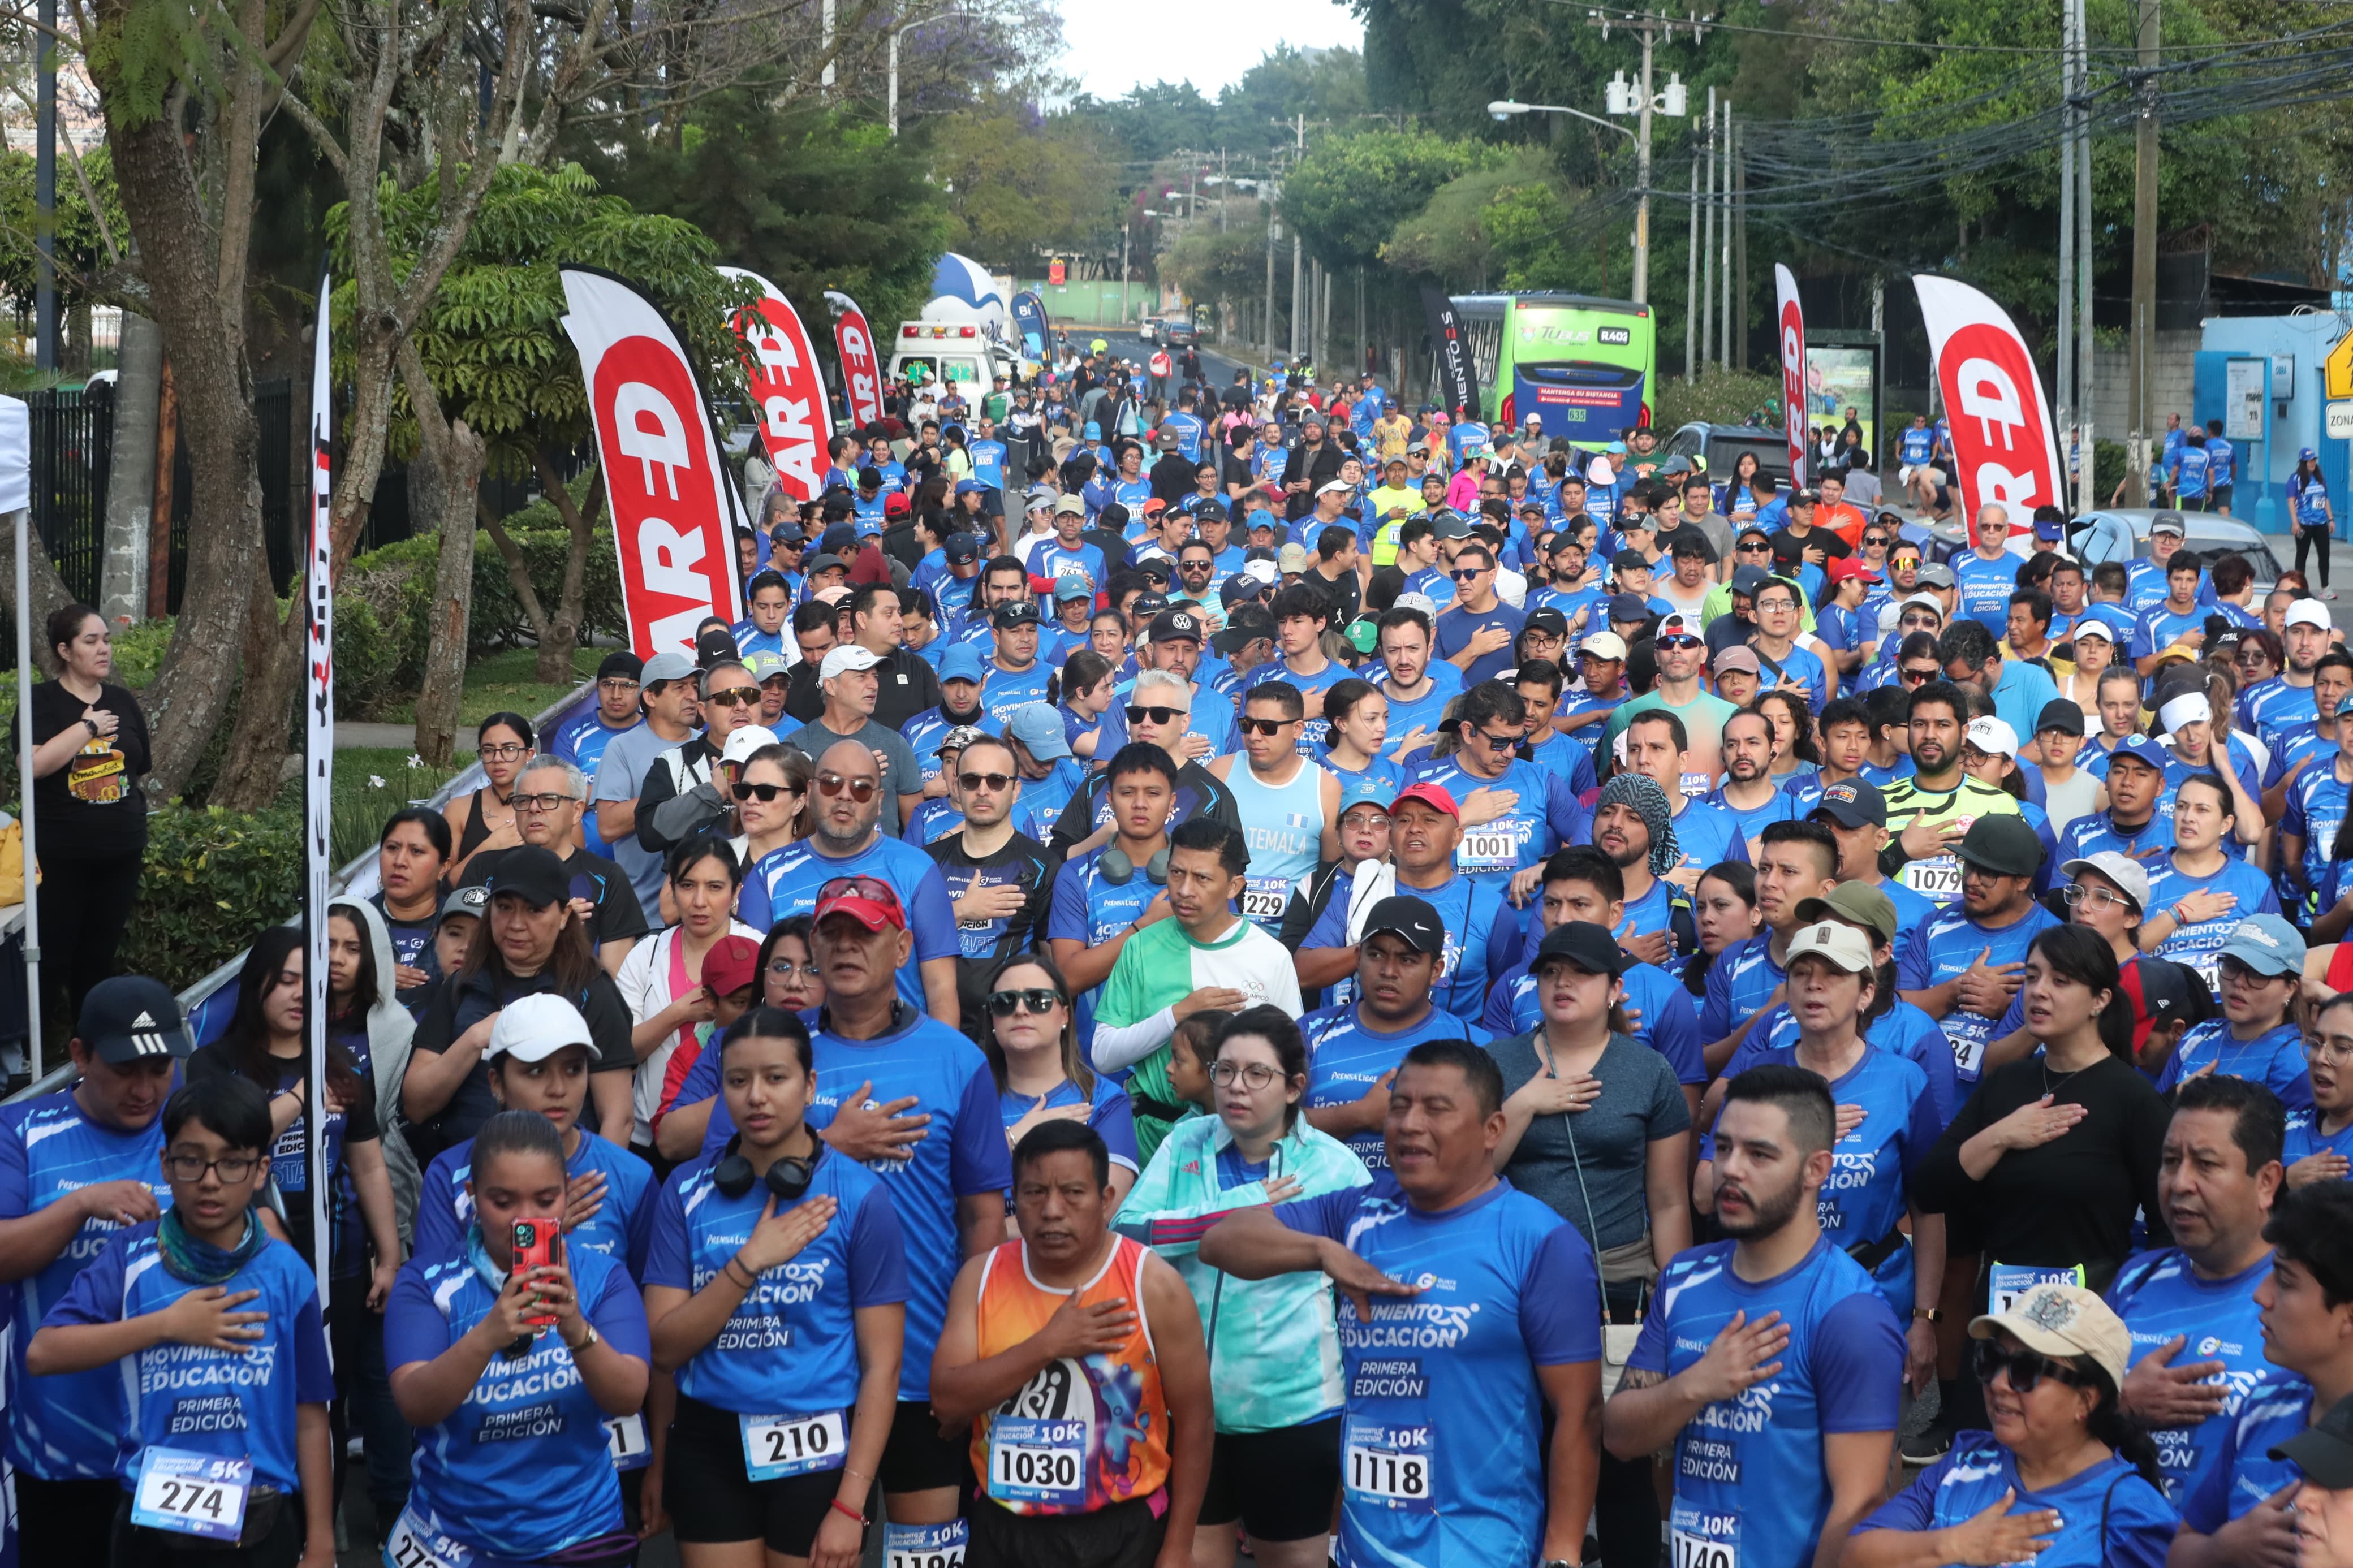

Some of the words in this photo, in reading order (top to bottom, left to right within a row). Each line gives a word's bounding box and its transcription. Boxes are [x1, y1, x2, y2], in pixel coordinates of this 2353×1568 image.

[1541, 388, 1575, 396] MANTENGA
[1569, 409, 1585, 421] 635
[1687, 774, 1707, 785] 10K
[1492, 820, 1515, 831] 10K
[1466, 837, 1509, 856] 1001
[1264, 879, 1287, 890] 10K
[1914, 869, 1962, 891] 1079
[1966, 1024, 1990, 1039] 5K
[1331, 1072, 1358, 1081] PRENSA
[1358, 1073, 1378, 1082] LIBRE
[816, 1095, 838, 1107] LIBRE
[706, 1234, 734, 1246] PRENSA
[725, 1315, 781, 1330] PRIMERA
[717, 1326, 788, 1350] EDICIÓN
[1341, 1325, 1458, 1348] EDUCACIÓN
[2221, 1341, 2243, 1350] GUATE
[2220, 1348, 2242, 1357] VISION
[1360, 1361, 1416, 1375] PRIMERA
[141, 1363, 272, 1394] EDUCACIÓN
[1354, 1374, 1423, 1397] EDICIÓN
[178, 1396, 242, 1413] PRIMERA
[171, 1410, 247, 1433] EDICIÓN
[485, 1403, 554, 1427] PRIMERA
[479, 1416, 562, 1442] EDICIÓN
[1041, 1423, 1083, 1443] 10K
[1388, 1428, 1428, 1448] 10K
[765, 1423, 828, 1462] 210
[1687, 1440, 1731, 1459] PRIMERA
[210, 1461, 244, 1479] 5K
[1001, 1450, 1075, 1487] 1030
[1354, 1453, 1423, 1494] 1118
[1682, 1454, 1737, 1482] EDICIÓN
[159, 1480, 223, 1520] 274
[931, 1521, 964, 1546] 10K
[1701, 1515, 1735, 1535] 10K
[434, 1536, 468, 1562] 5K
